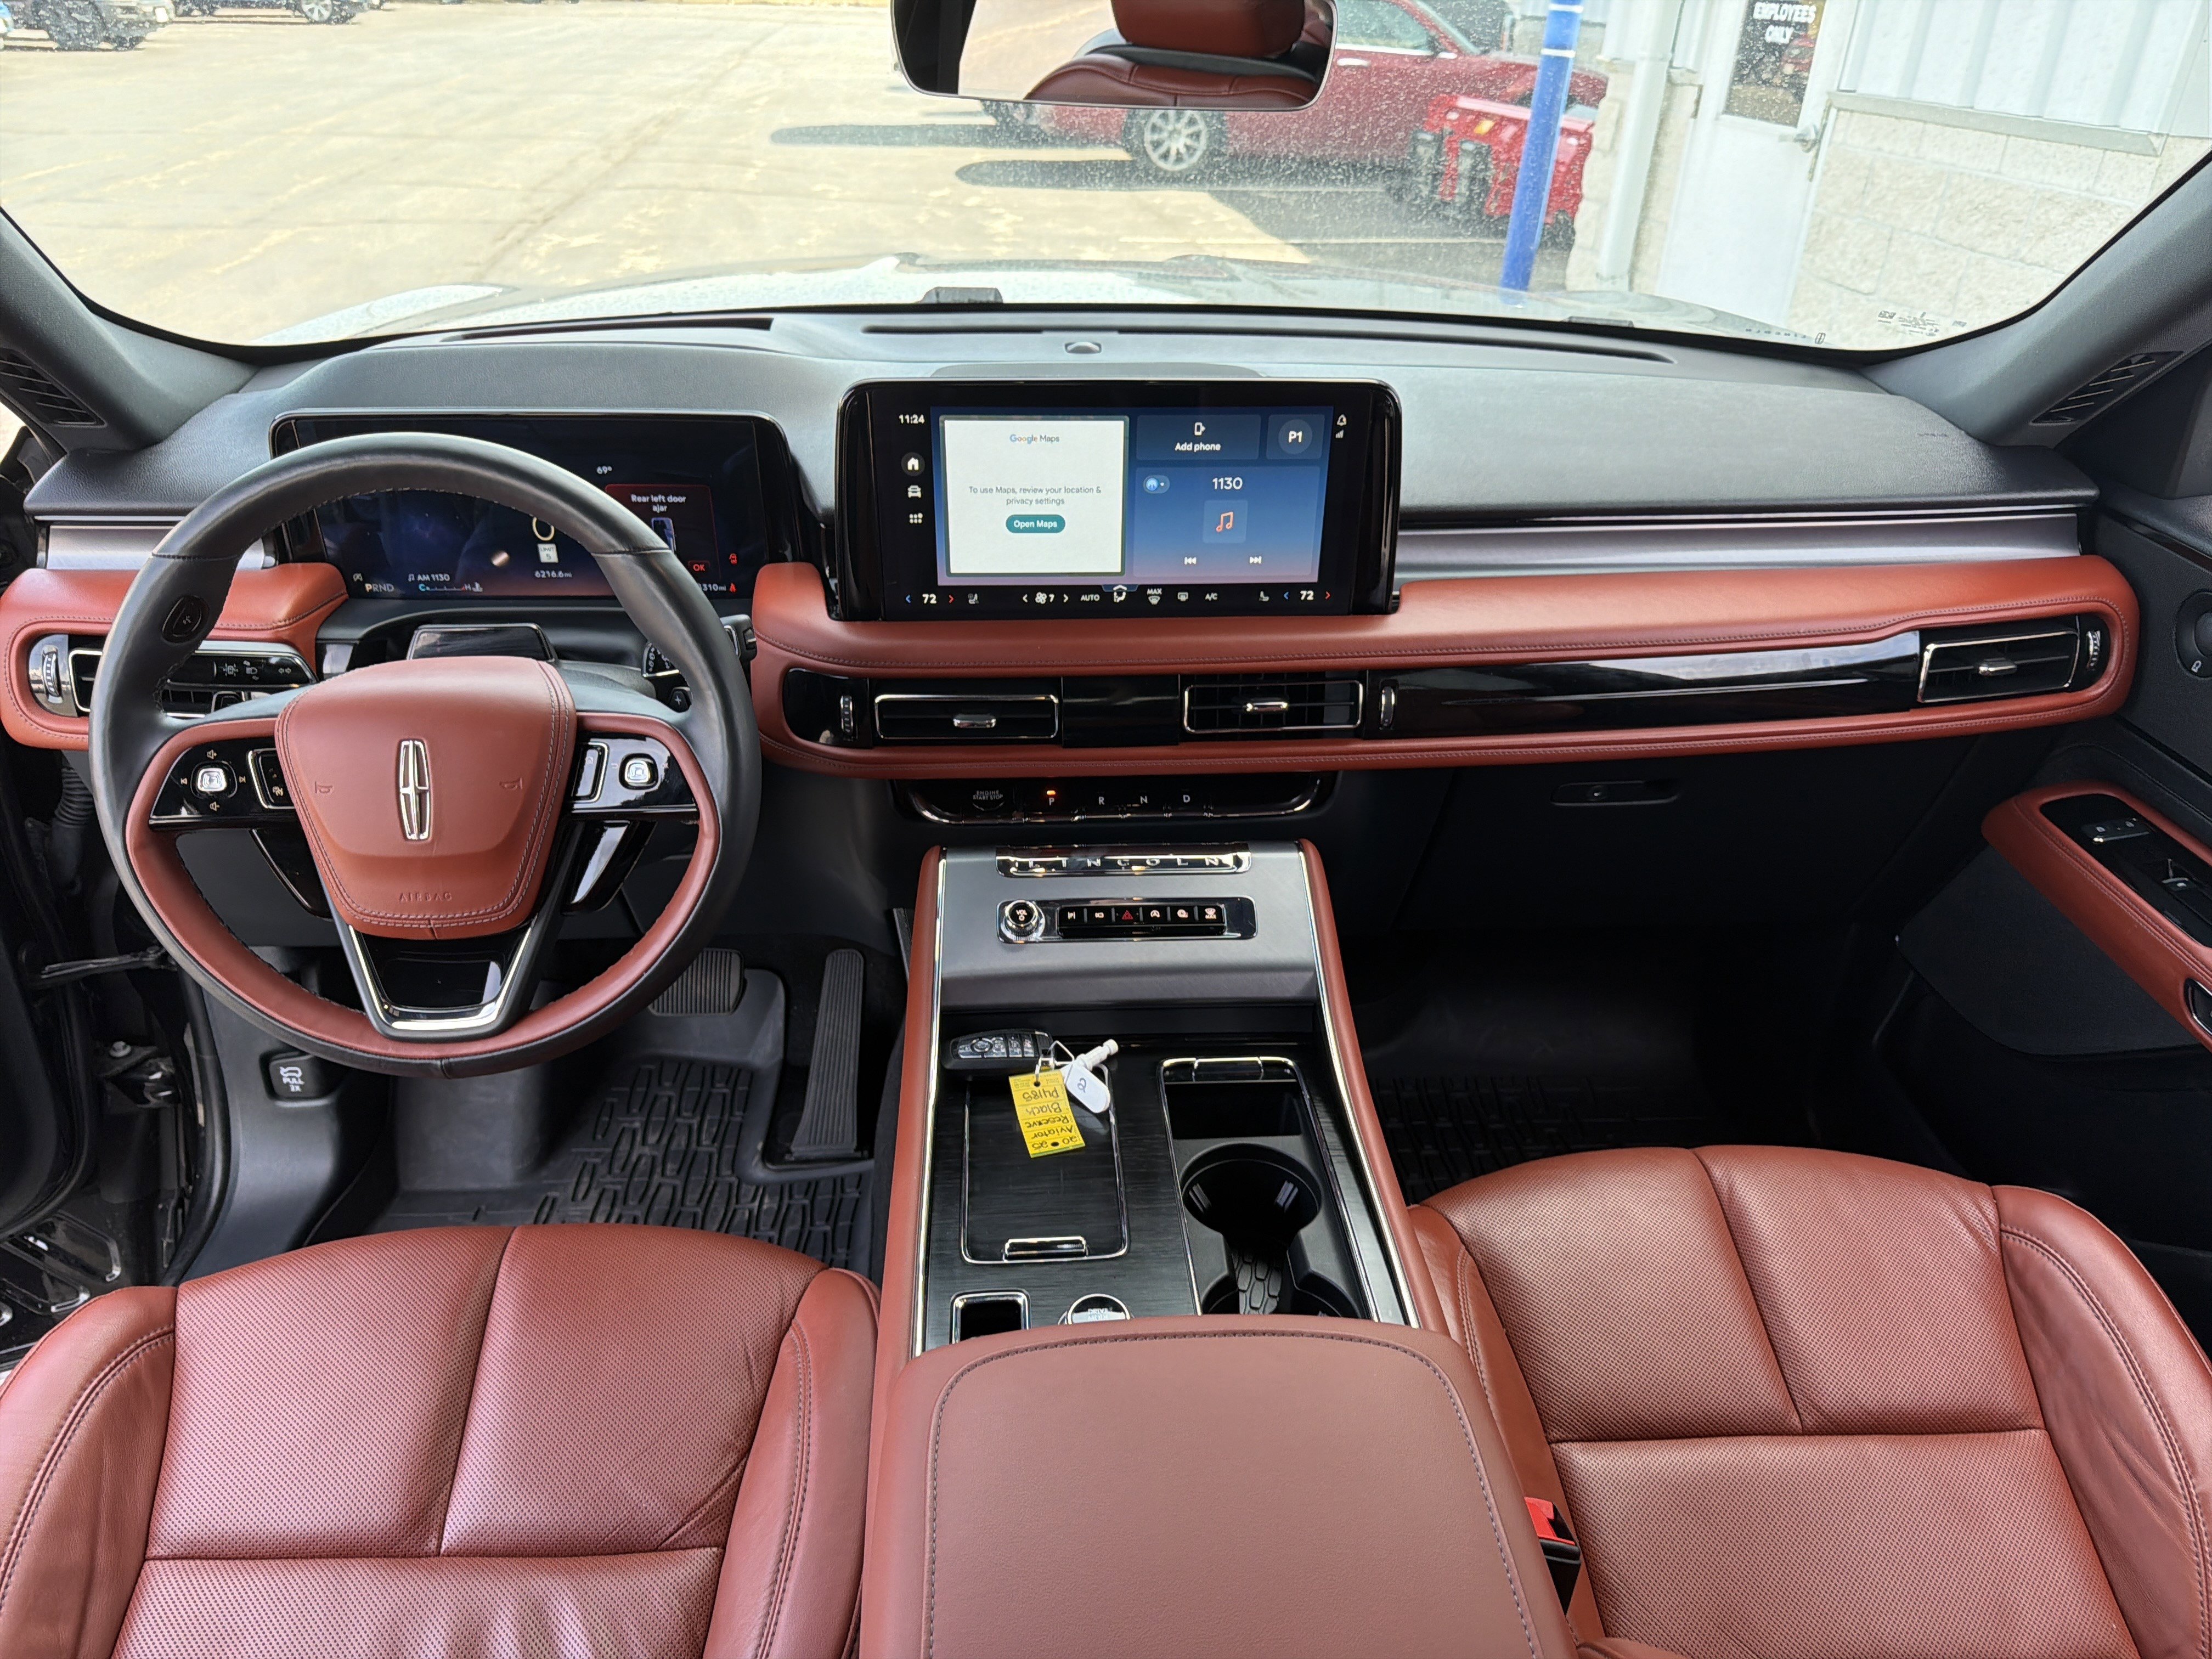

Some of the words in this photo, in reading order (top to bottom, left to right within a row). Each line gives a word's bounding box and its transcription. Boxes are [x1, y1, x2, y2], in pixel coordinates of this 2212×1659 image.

[899, 414, 925, 424] 11:24
[1010, 434, 1037, 444] Google
[1039, 434, 1060, 443] Maps
[1288, 431, 1303, 443] P1
[1175, 442, 1193, 451] Add
[1194, 442, 1221, 453] phone
[1212, 477, 1243, 490] 1130
[1045, 487, 1062, 495] your
[631, 494, 650, 503] Rear
[651, 494, 666, 503] left
[667, 494, 686, 503] door
[1006, 498, 1034, 506] privacy
[1035, 498, 1065, 506] settings
[652, 504, 668, 514] ajar
[1013, 520, 1035, 529] Open
[1036, 520, 1058, 529] Maps
[693, 563, 706, 572] OK
[431, 573, 450, 582] 1130
[922, 593, 937, 604] 72
[1048, 594, 1055, 603] 7
[1080, 594, 1101, 602] AUTO
[1205, 592, 1218, 601] A/C
[1300, 590, 1314, 601] 72
[1048, 797, 1055, 806] P
[1098, 796, 1105, 805] R
[1139, 795, 1148, 804] N
[1183, 794, 1190, 803] D
[1029, 857, 1220, 868] LINCOLN
[399, 890, 453, 902] AIRBAG
[282, 1077, 305, 1085] PULL
[1022, 1087, 1059, 1102] P4185
[1025, 1102, 1063, 1116] Black
[1024, 1115, 1070, 1128] Reserve
[1031, 1125, 1073, 1140] Aviator
[1031, 1140, 1049, 1150] 25
[1062, 1135, 1078, 1145] 20
